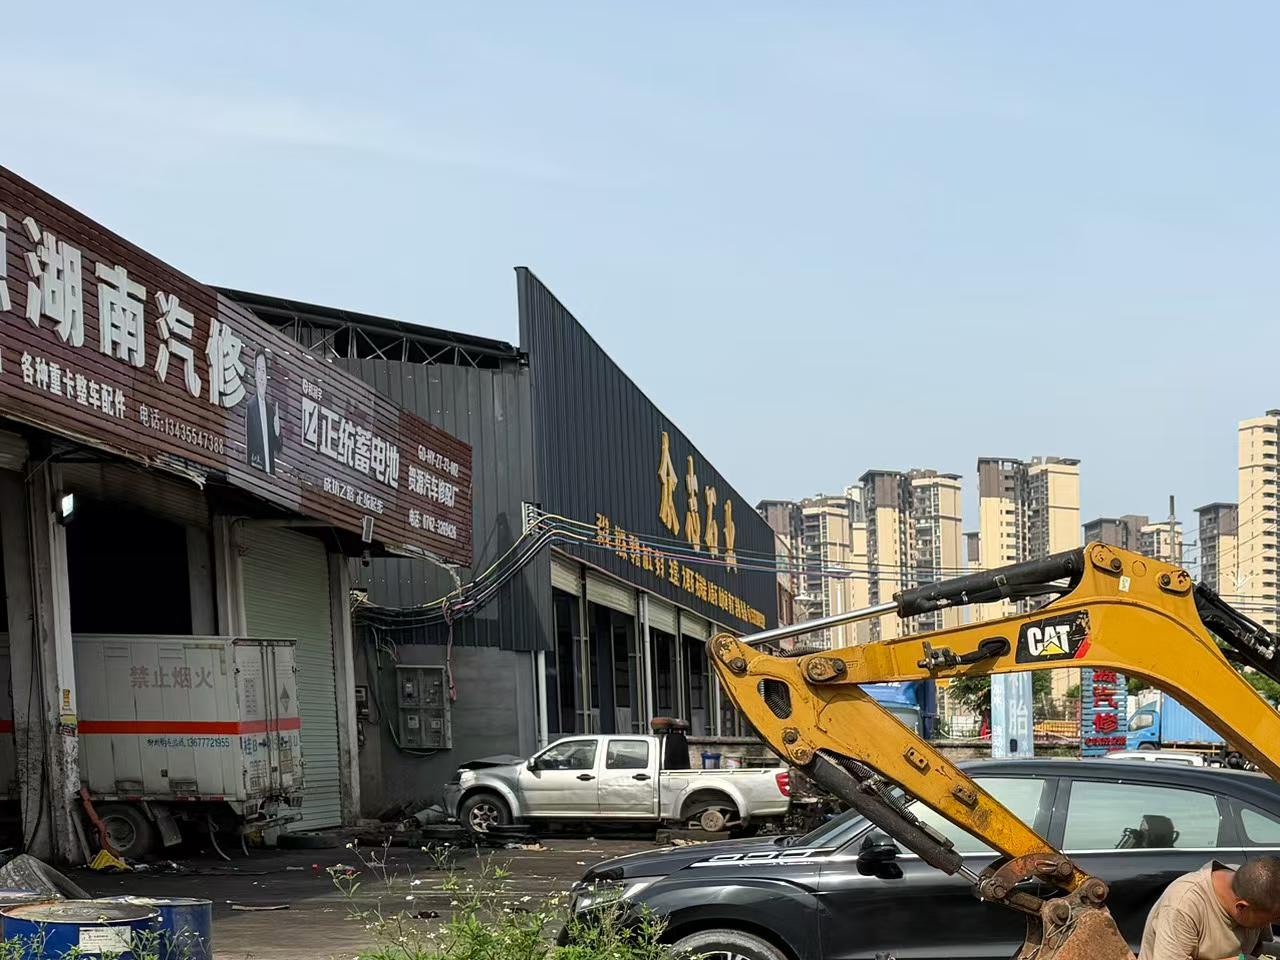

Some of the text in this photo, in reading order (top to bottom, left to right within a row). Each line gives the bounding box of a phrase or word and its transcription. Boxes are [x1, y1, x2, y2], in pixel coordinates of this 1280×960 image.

[0, 210, 248, 409] 湖南汽修
[21, 350, 126, 420] 各种重卡整车配件
[319, 406, 400, 490] 正统蓄电池
[1027, 624, 1070, 656] CAT
[129, 666, 213, 689] 禁止烟火
